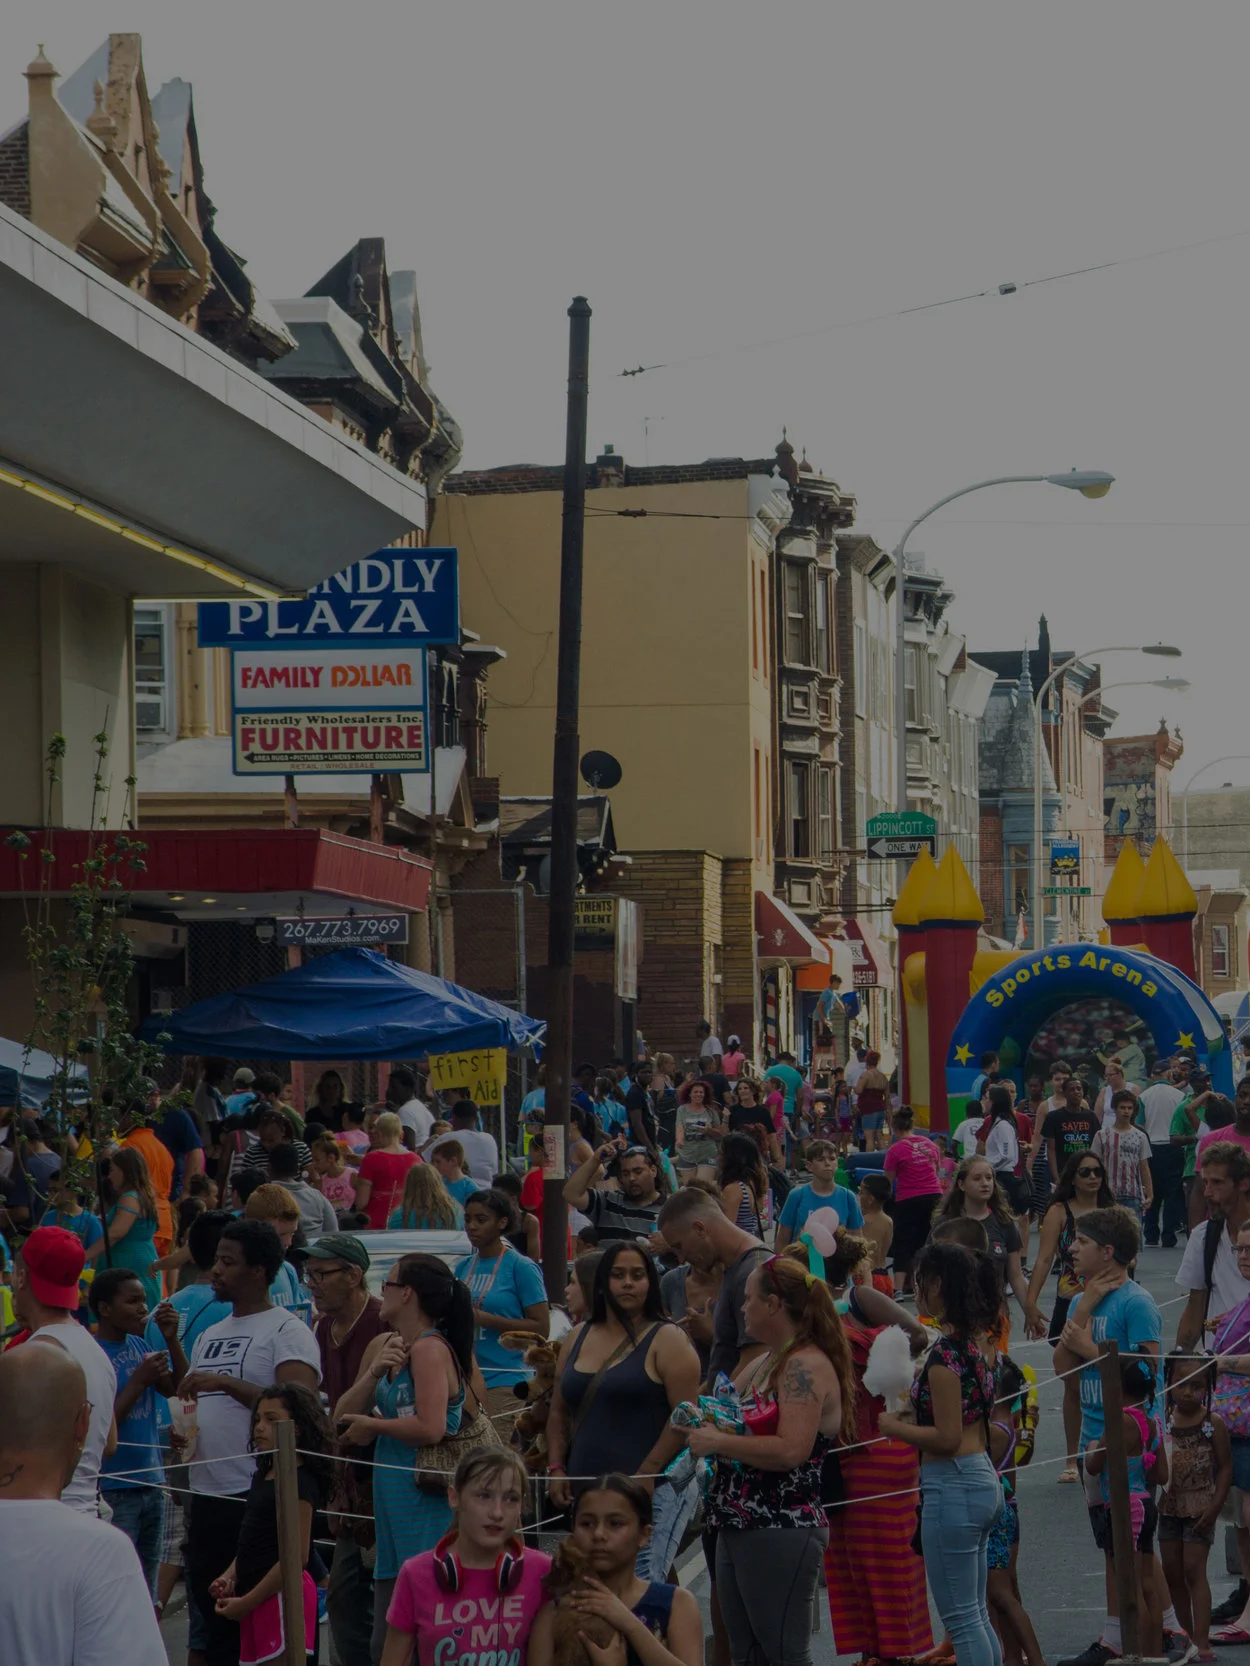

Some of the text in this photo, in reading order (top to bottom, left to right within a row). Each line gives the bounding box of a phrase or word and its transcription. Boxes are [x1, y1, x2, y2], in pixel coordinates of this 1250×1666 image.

[308, 558, 445, 594] NDLY
[227, 599, 430, 638] PLAZA
[241, 663, 413, 689] FAMILY DOLLAR
[241, 714, 422, 726] Friendly Wholesalers Inc.
[241, 725, 423, 752] FURNITURE
[868, 821, 934, 835] LIPPINCOTT ST
[888, 842, 928, 852] ONE WA
[283, 919, 400, 938] 267.773.7969
[583, 914, 612, 924] RENT
[985, 951, 1159, 1008] Sports Arena
[433, 1050, 495, 1082] first
[474, 1078, 499, 1101] Aid
[1061, 1121, 1090, 1131] SAVED
[1064, 1133, 1089, 1141] GRACE
[434, 1595, 525, 1626] LOVE
[471, 1622, 523, 1648] MY
